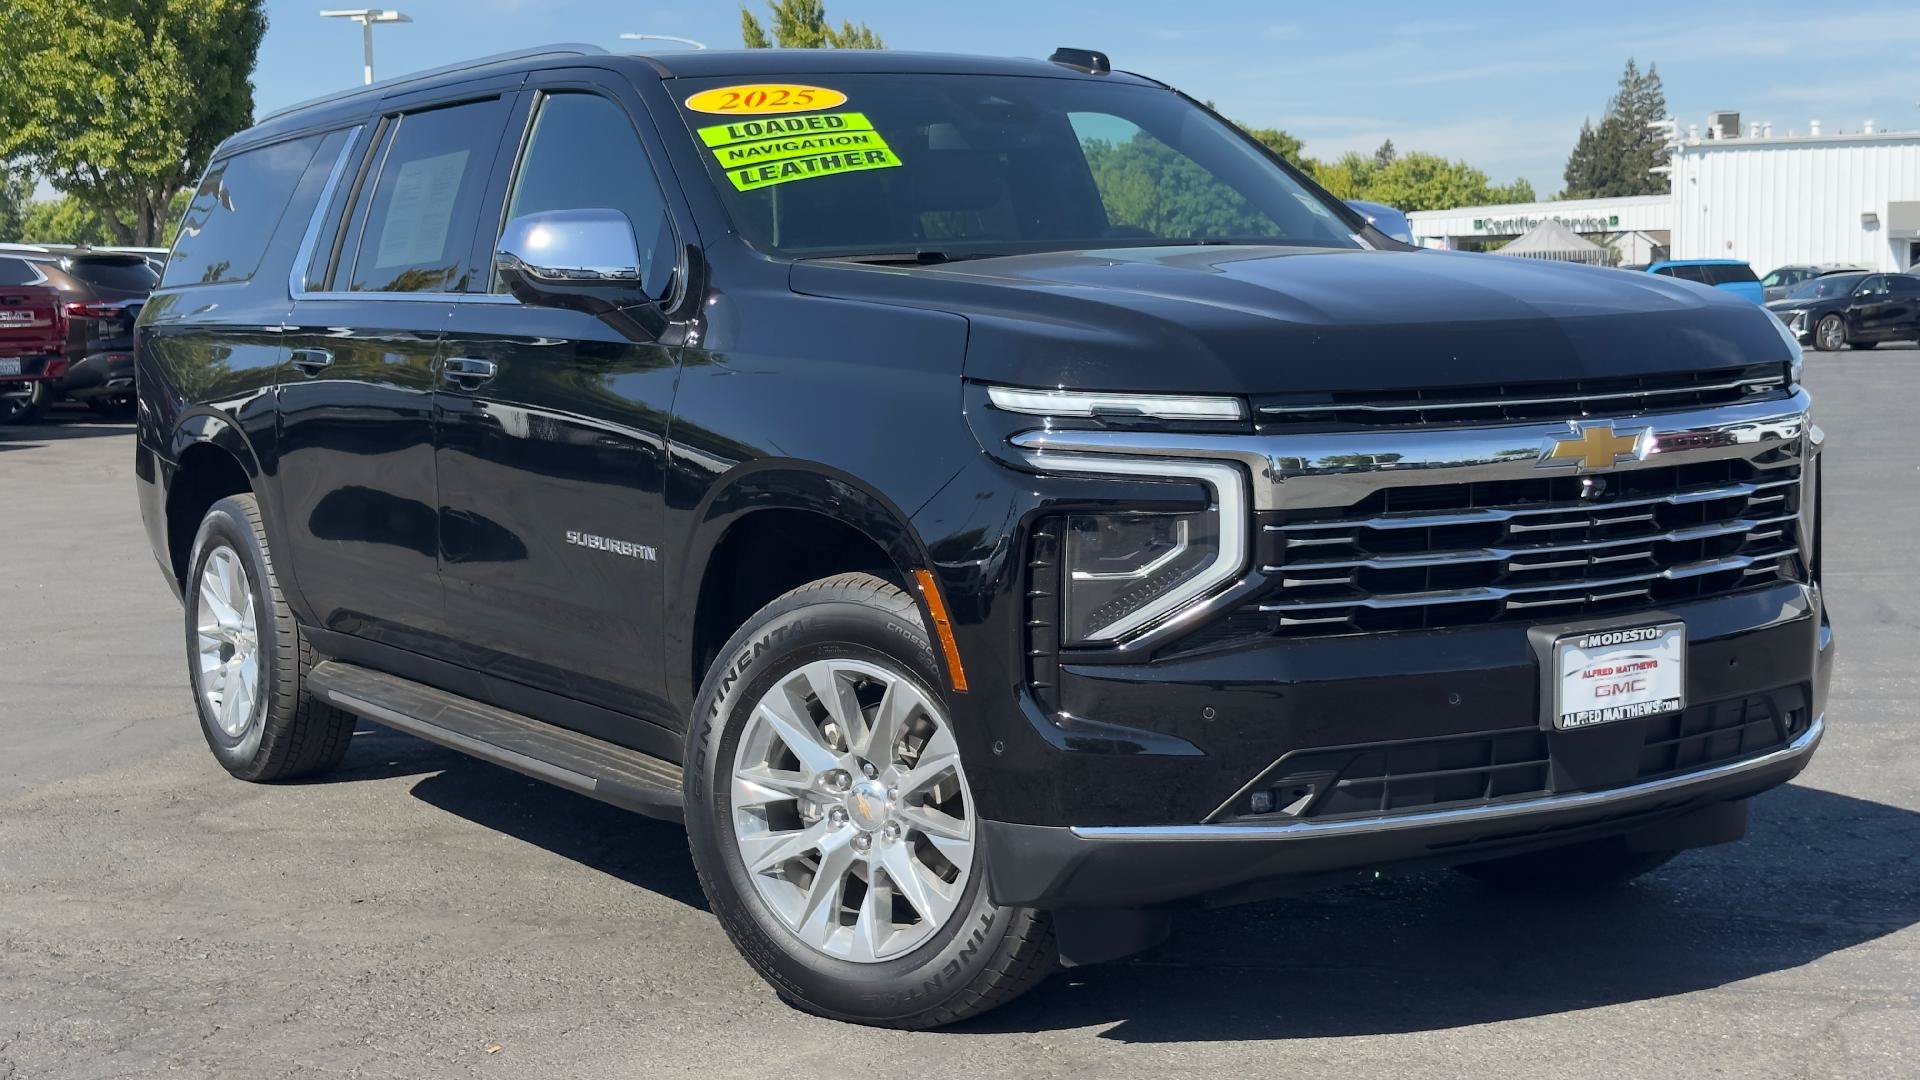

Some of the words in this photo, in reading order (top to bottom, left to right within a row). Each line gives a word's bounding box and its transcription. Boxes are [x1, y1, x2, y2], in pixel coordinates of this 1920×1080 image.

[718, 89, 816, 110] 2025
[728, 115, 845, 140] LOADED
[728, 135, 870, 160] NAVIGATION
[739, 150, 888, 186] LEATHER
[565, 530, 657, 562] SUBURBAN
[1587, 628, 1657, 648] MODESTO
[1582, 667, 1614, 679] ALFRED
[1616, 660, 1658, 674] MATTHEWS
[1595, 679, 1646, 698] GMC
